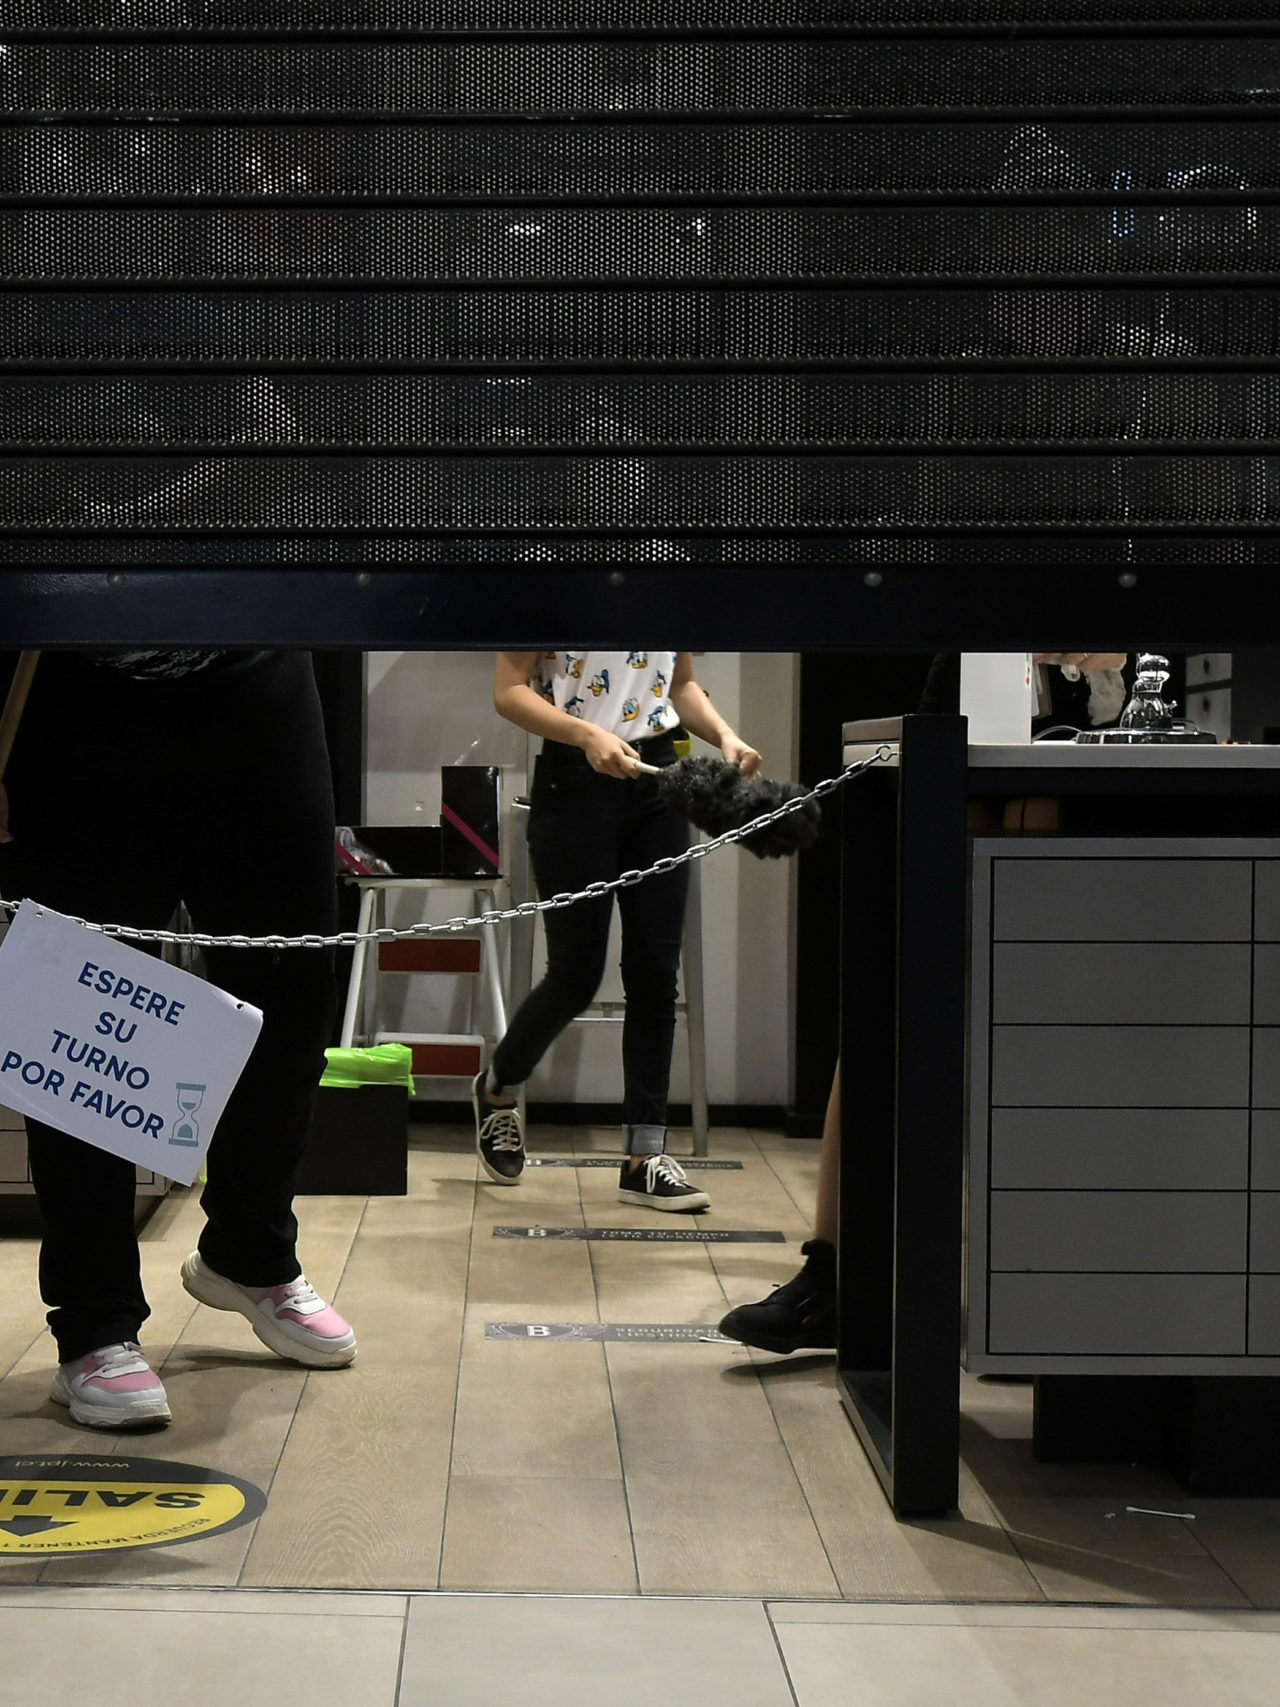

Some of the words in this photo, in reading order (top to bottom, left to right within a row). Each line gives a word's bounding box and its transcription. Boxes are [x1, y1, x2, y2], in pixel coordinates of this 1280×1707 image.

[77, 961, 186, 1027] ESPERE
[94, 1011, 138, 1044] SU
[51, 1029, 151, 1091] TURNO
[0, 1050, 66, 1096] POR
[69, 1082, 165, 1140] FAVOR
[526, 1324, 551, 1337] B
[15, 1460, 130, 1469] www.jpt.cl
[19, 1536, 128, 1548] MANTENER
[131, 1518, 210, 1540] RECUERDA
